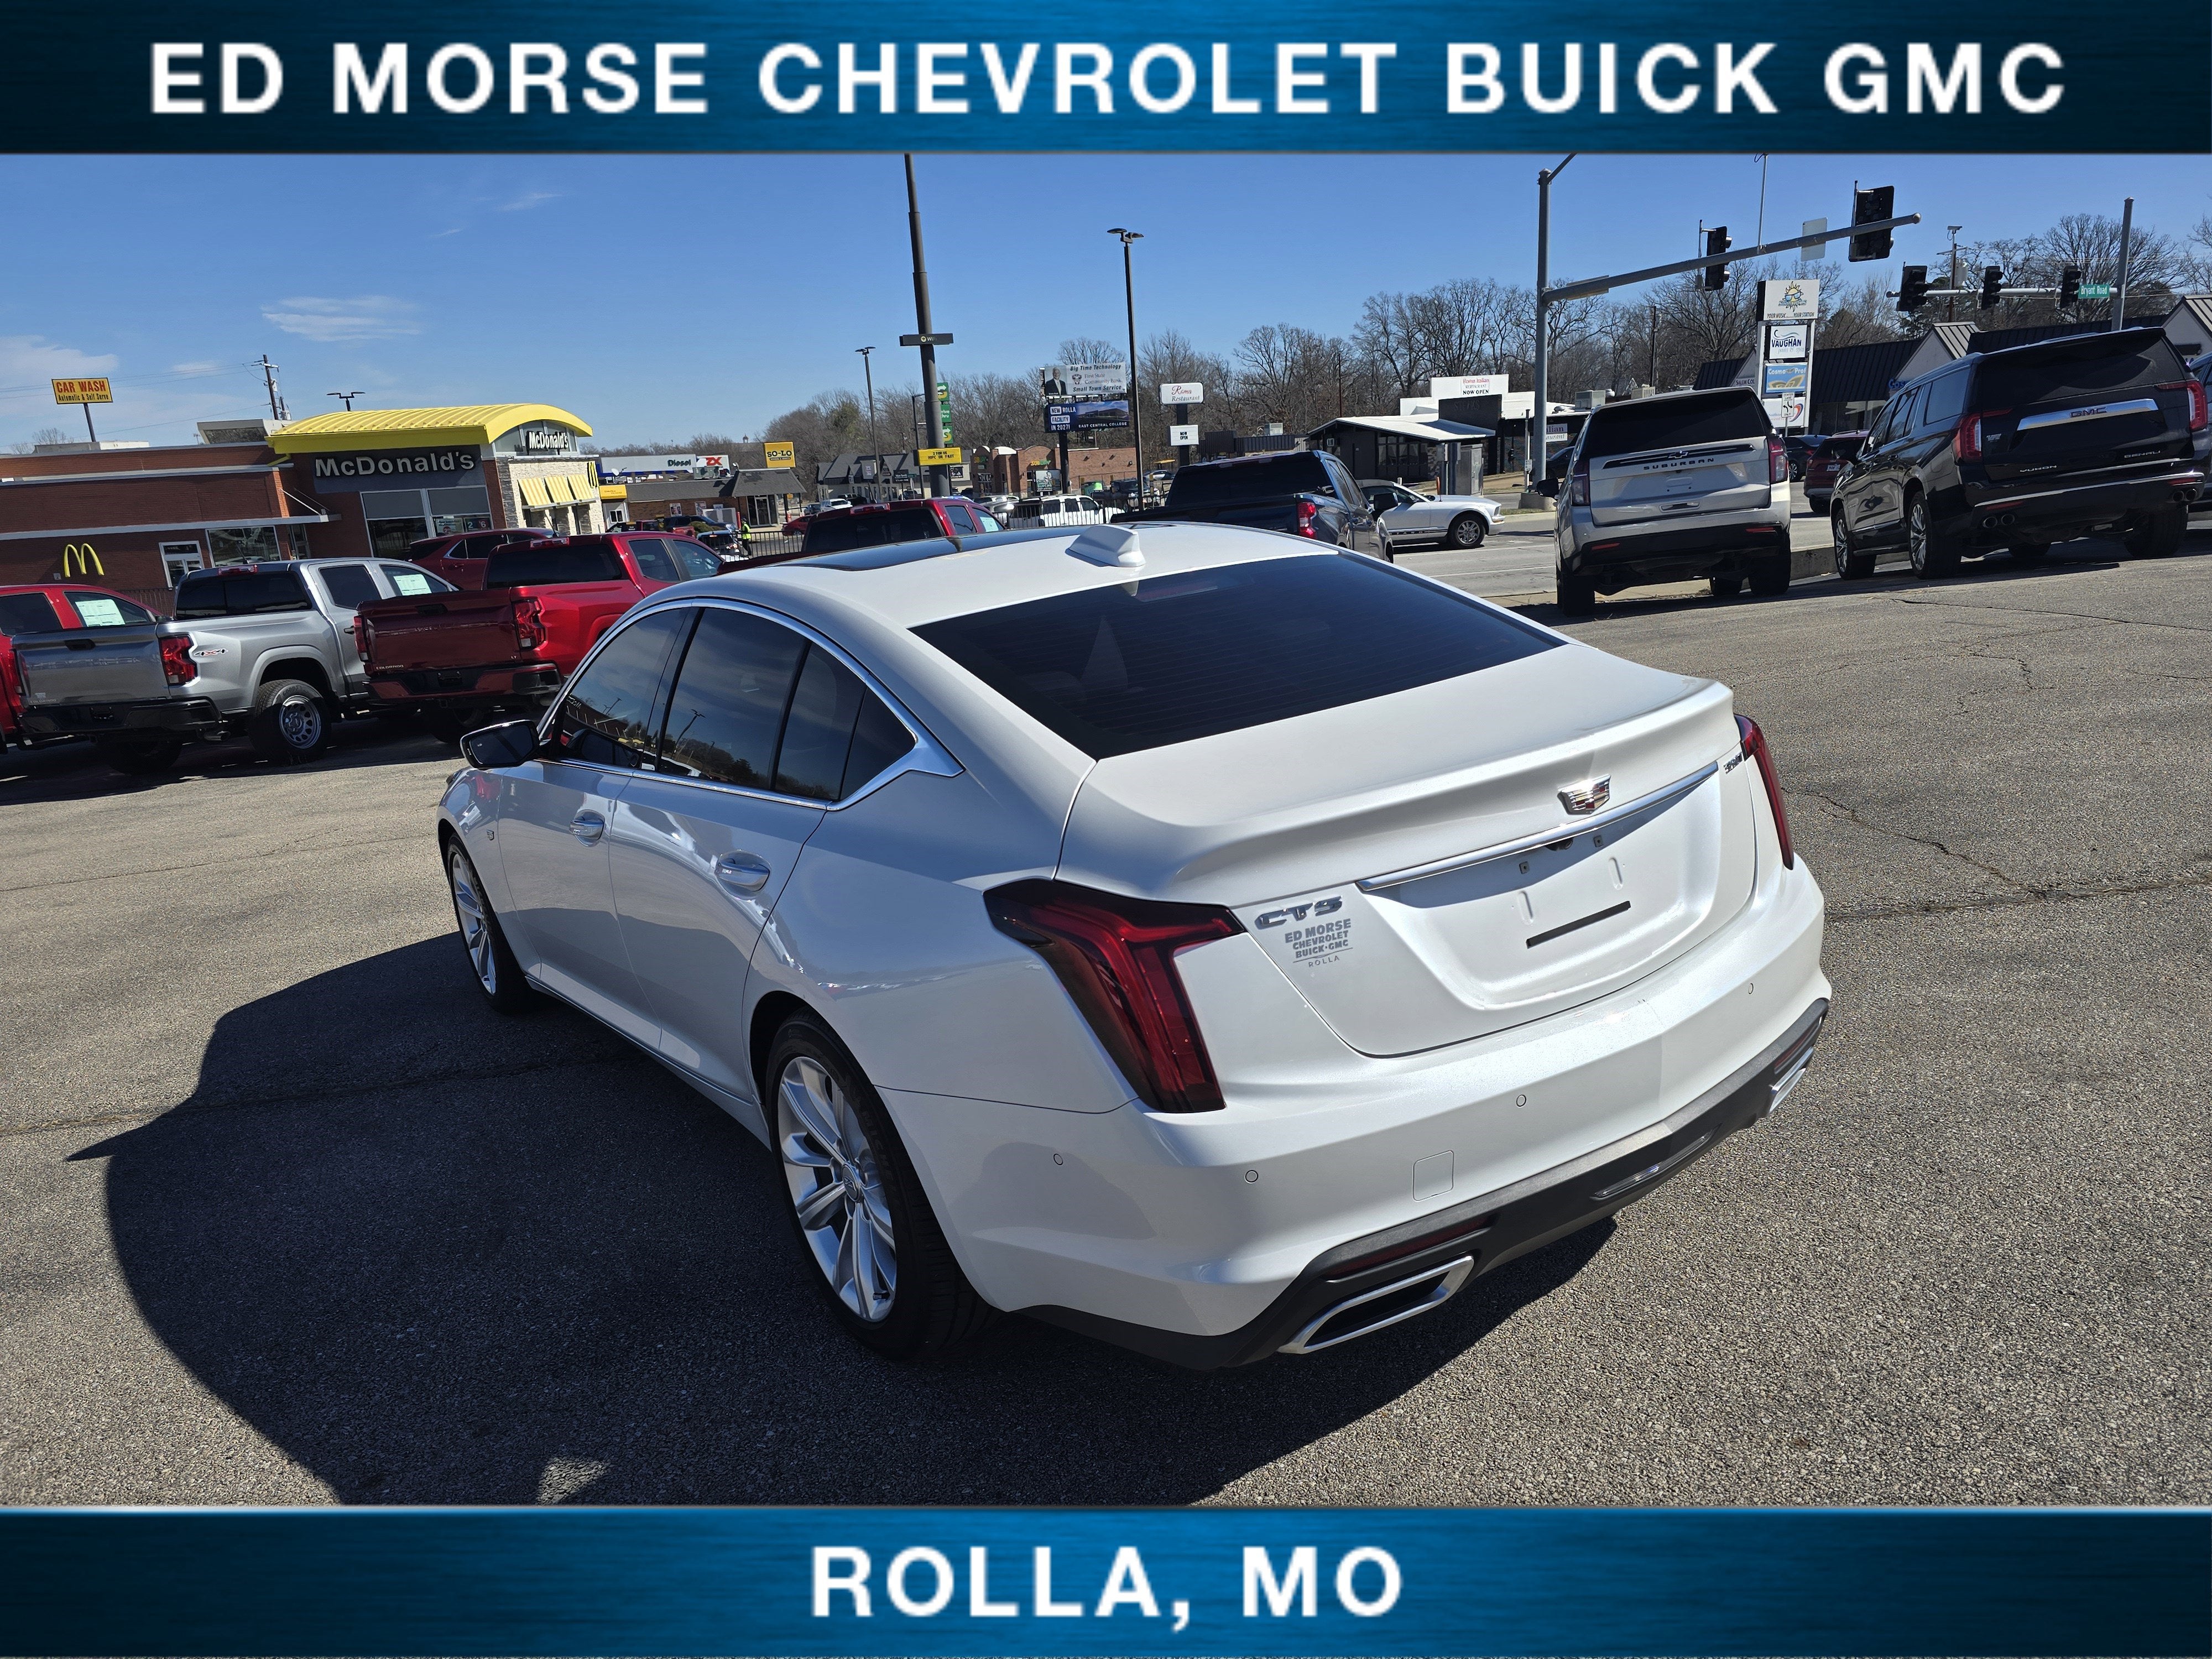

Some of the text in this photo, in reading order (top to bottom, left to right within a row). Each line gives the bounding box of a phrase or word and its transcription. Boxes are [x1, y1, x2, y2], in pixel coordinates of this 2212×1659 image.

[2081, 285, 2107, 296] Bryant Road
[1771, 338, 1802, 348] VAUGHAN
[56, 380, 106, 393] CAR WASH
[1171, 385, 1192, 395] Roma
[2069, 407, 2107, 418] GMC
[528, 431, 568, 450] McDonald's
[315, 451, 475, 477] McDonald's
[1644, 458, 1714, 470] SUBURBAN
[1284, 918, 1351, 943] ED MORSE
[1292, 930, 1349, 950] CHEVROLET
[1308, 955, 1340, 967] ROLLA
